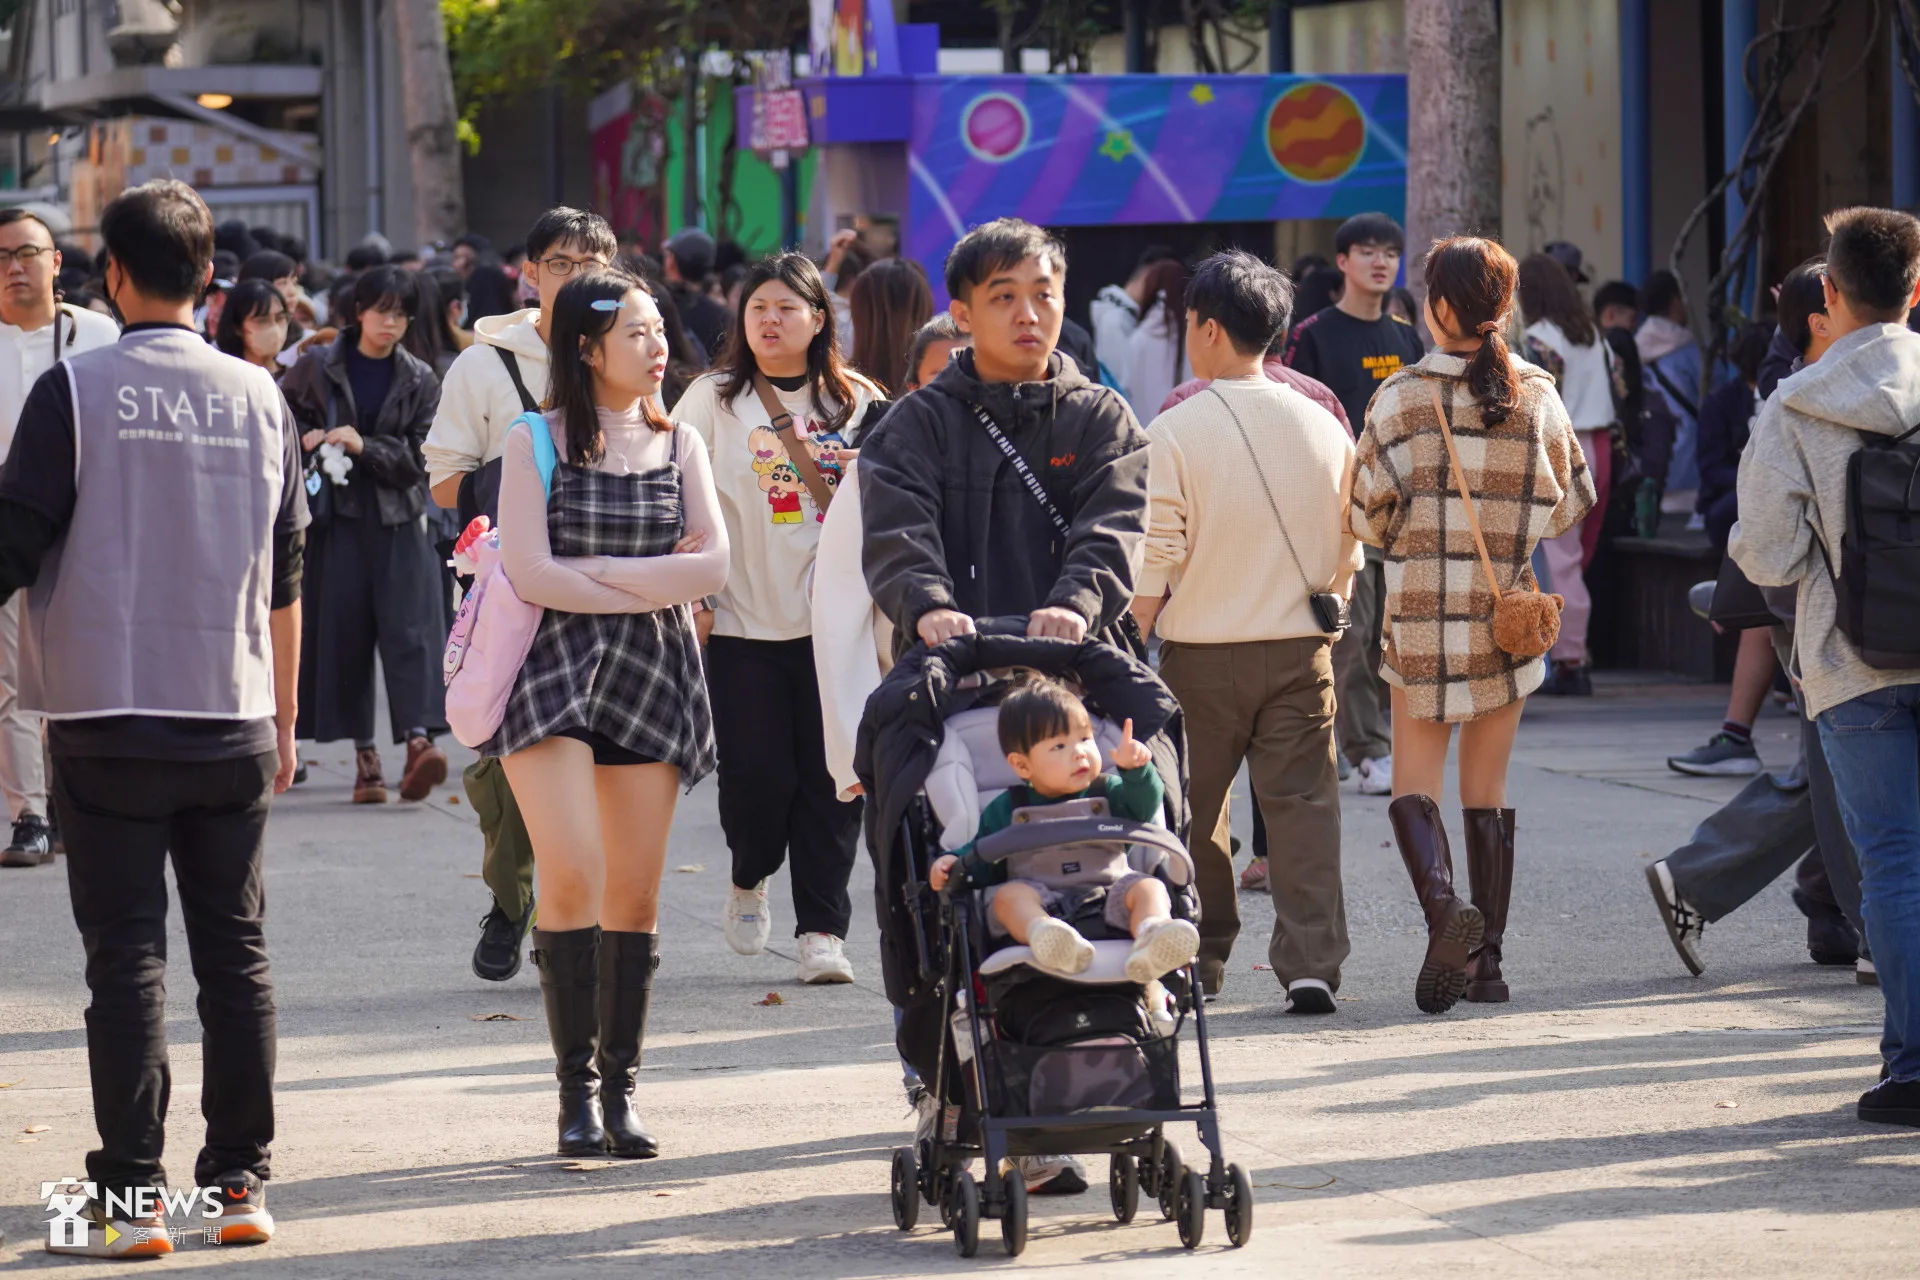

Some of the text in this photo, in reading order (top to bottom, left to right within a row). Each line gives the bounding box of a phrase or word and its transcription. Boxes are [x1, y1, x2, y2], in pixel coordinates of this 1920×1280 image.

[1362, 355, 1399, 368] MIAMI
[117, 385, 249, 429] STAFF
[979, 412, 990, 424] IN
[986, 421, 1002, 439] THE
[997, 436, 1017, 457] PAST
[1012, 456, 1029, 474] THE
[1024, 473, 1048, 505] FUTURE
[1053, 514, 1065, 527] IN
